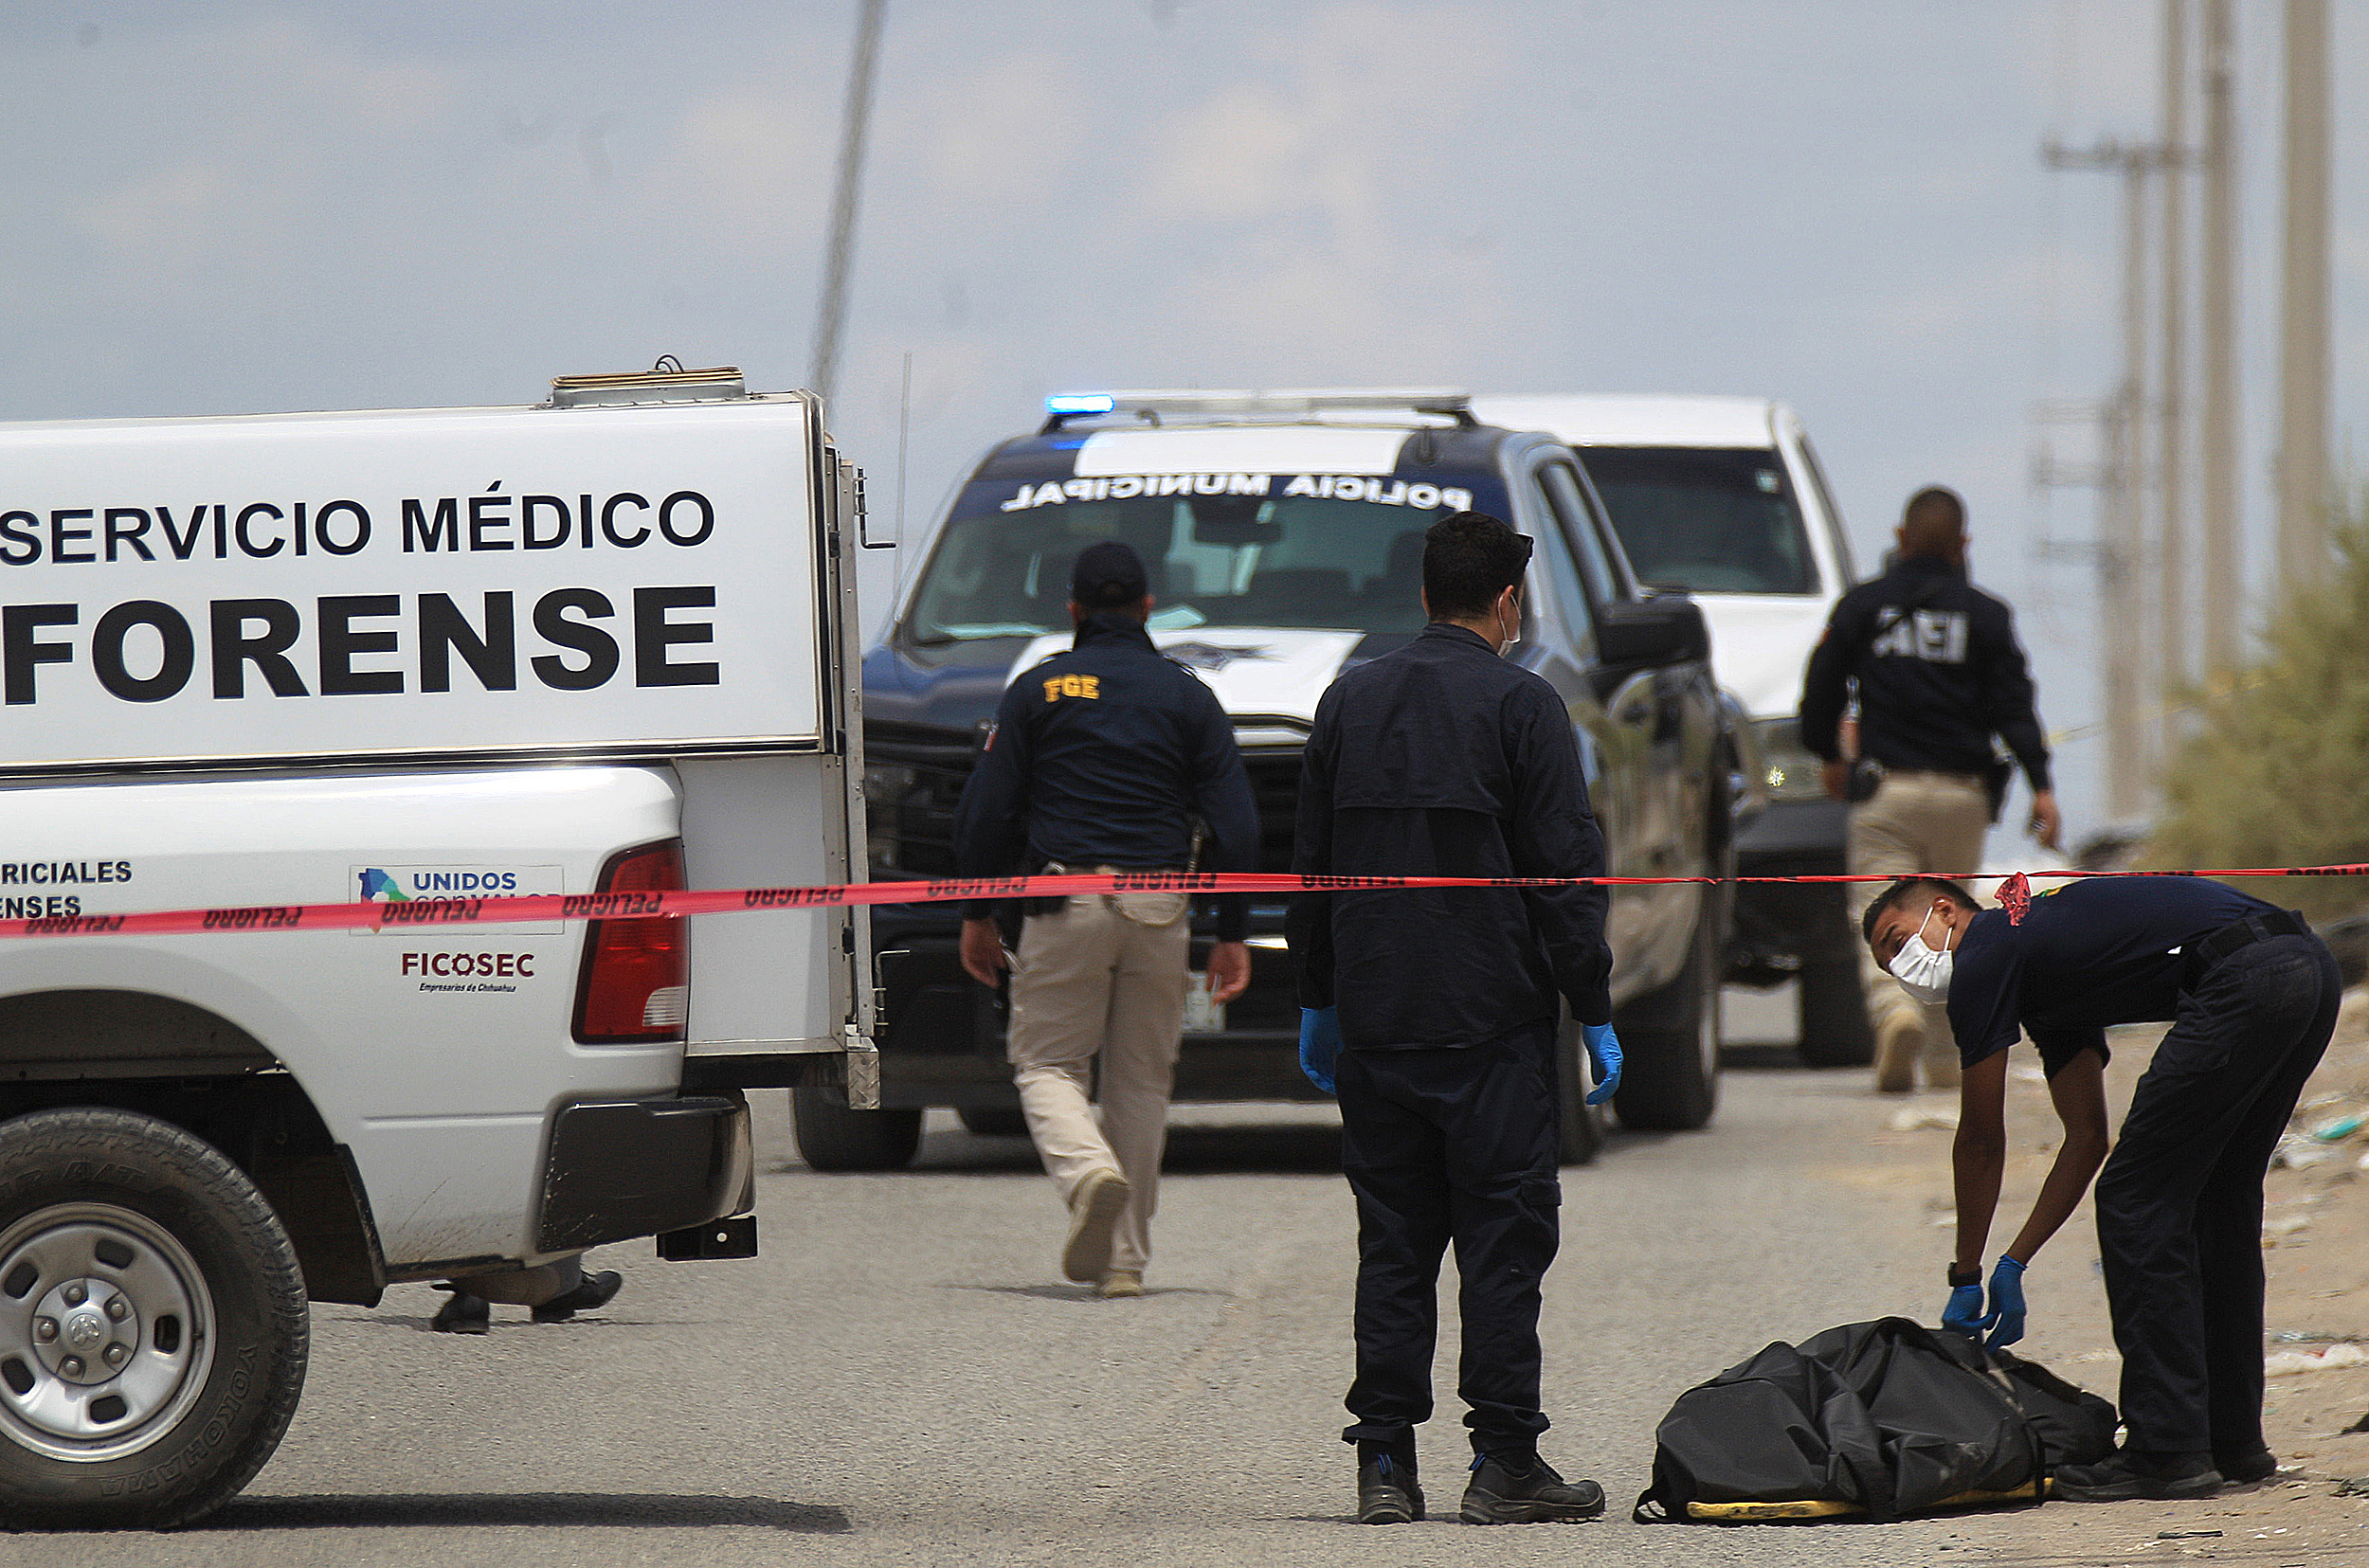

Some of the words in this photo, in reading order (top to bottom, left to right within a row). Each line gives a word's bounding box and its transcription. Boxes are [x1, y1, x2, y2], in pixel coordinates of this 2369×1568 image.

[0, 500, 373, 566] SERVICIO
[401, 479, 715, 553] MÉDICO
[2, 586, 720, 705] FORENSE
[1043, 674, 1100, 703] FGE
[413, 872, 517, 891] UNIDOS
[0, 895, 81, 918] NSES
[401, 952, 535, 978] FICOSEC
